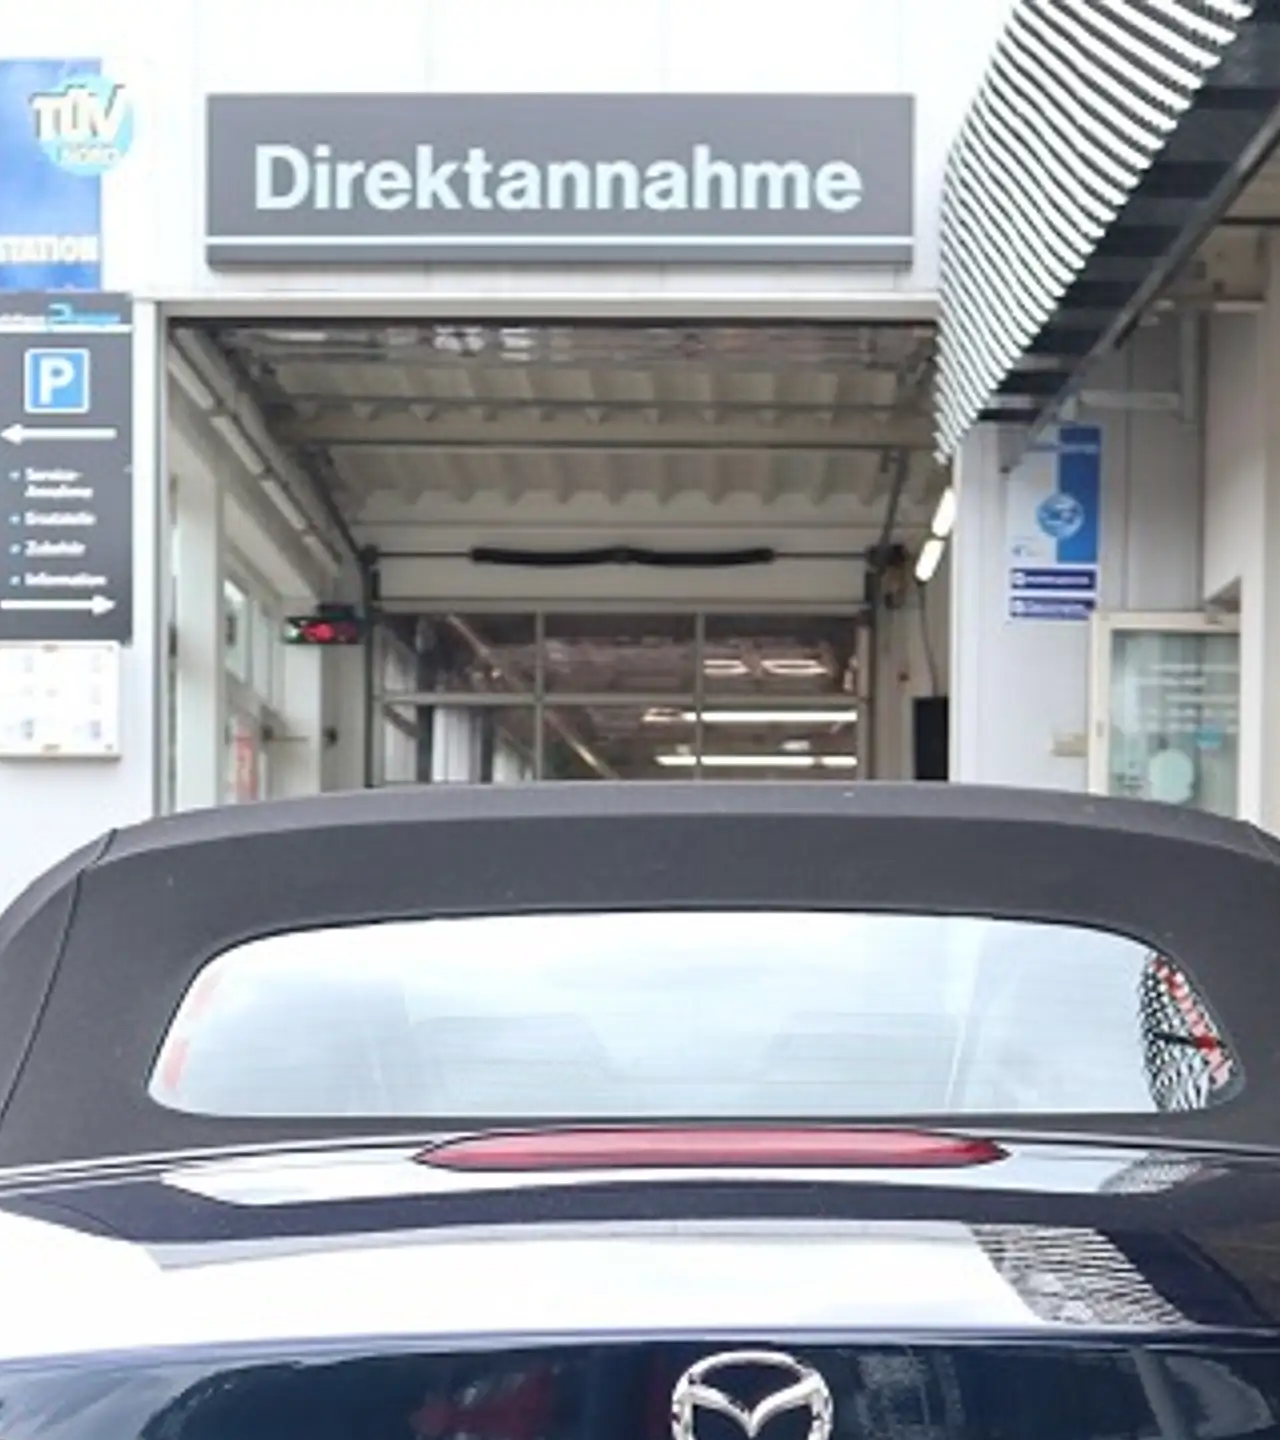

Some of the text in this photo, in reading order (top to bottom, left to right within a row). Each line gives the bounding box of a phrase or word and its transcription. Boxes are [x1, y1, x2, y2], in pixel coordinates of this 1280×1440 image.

[28, 81, 126, 143] TÜV
[253, 143, 863, 212] Direktannahme
[39, 357, 76, 406] P
